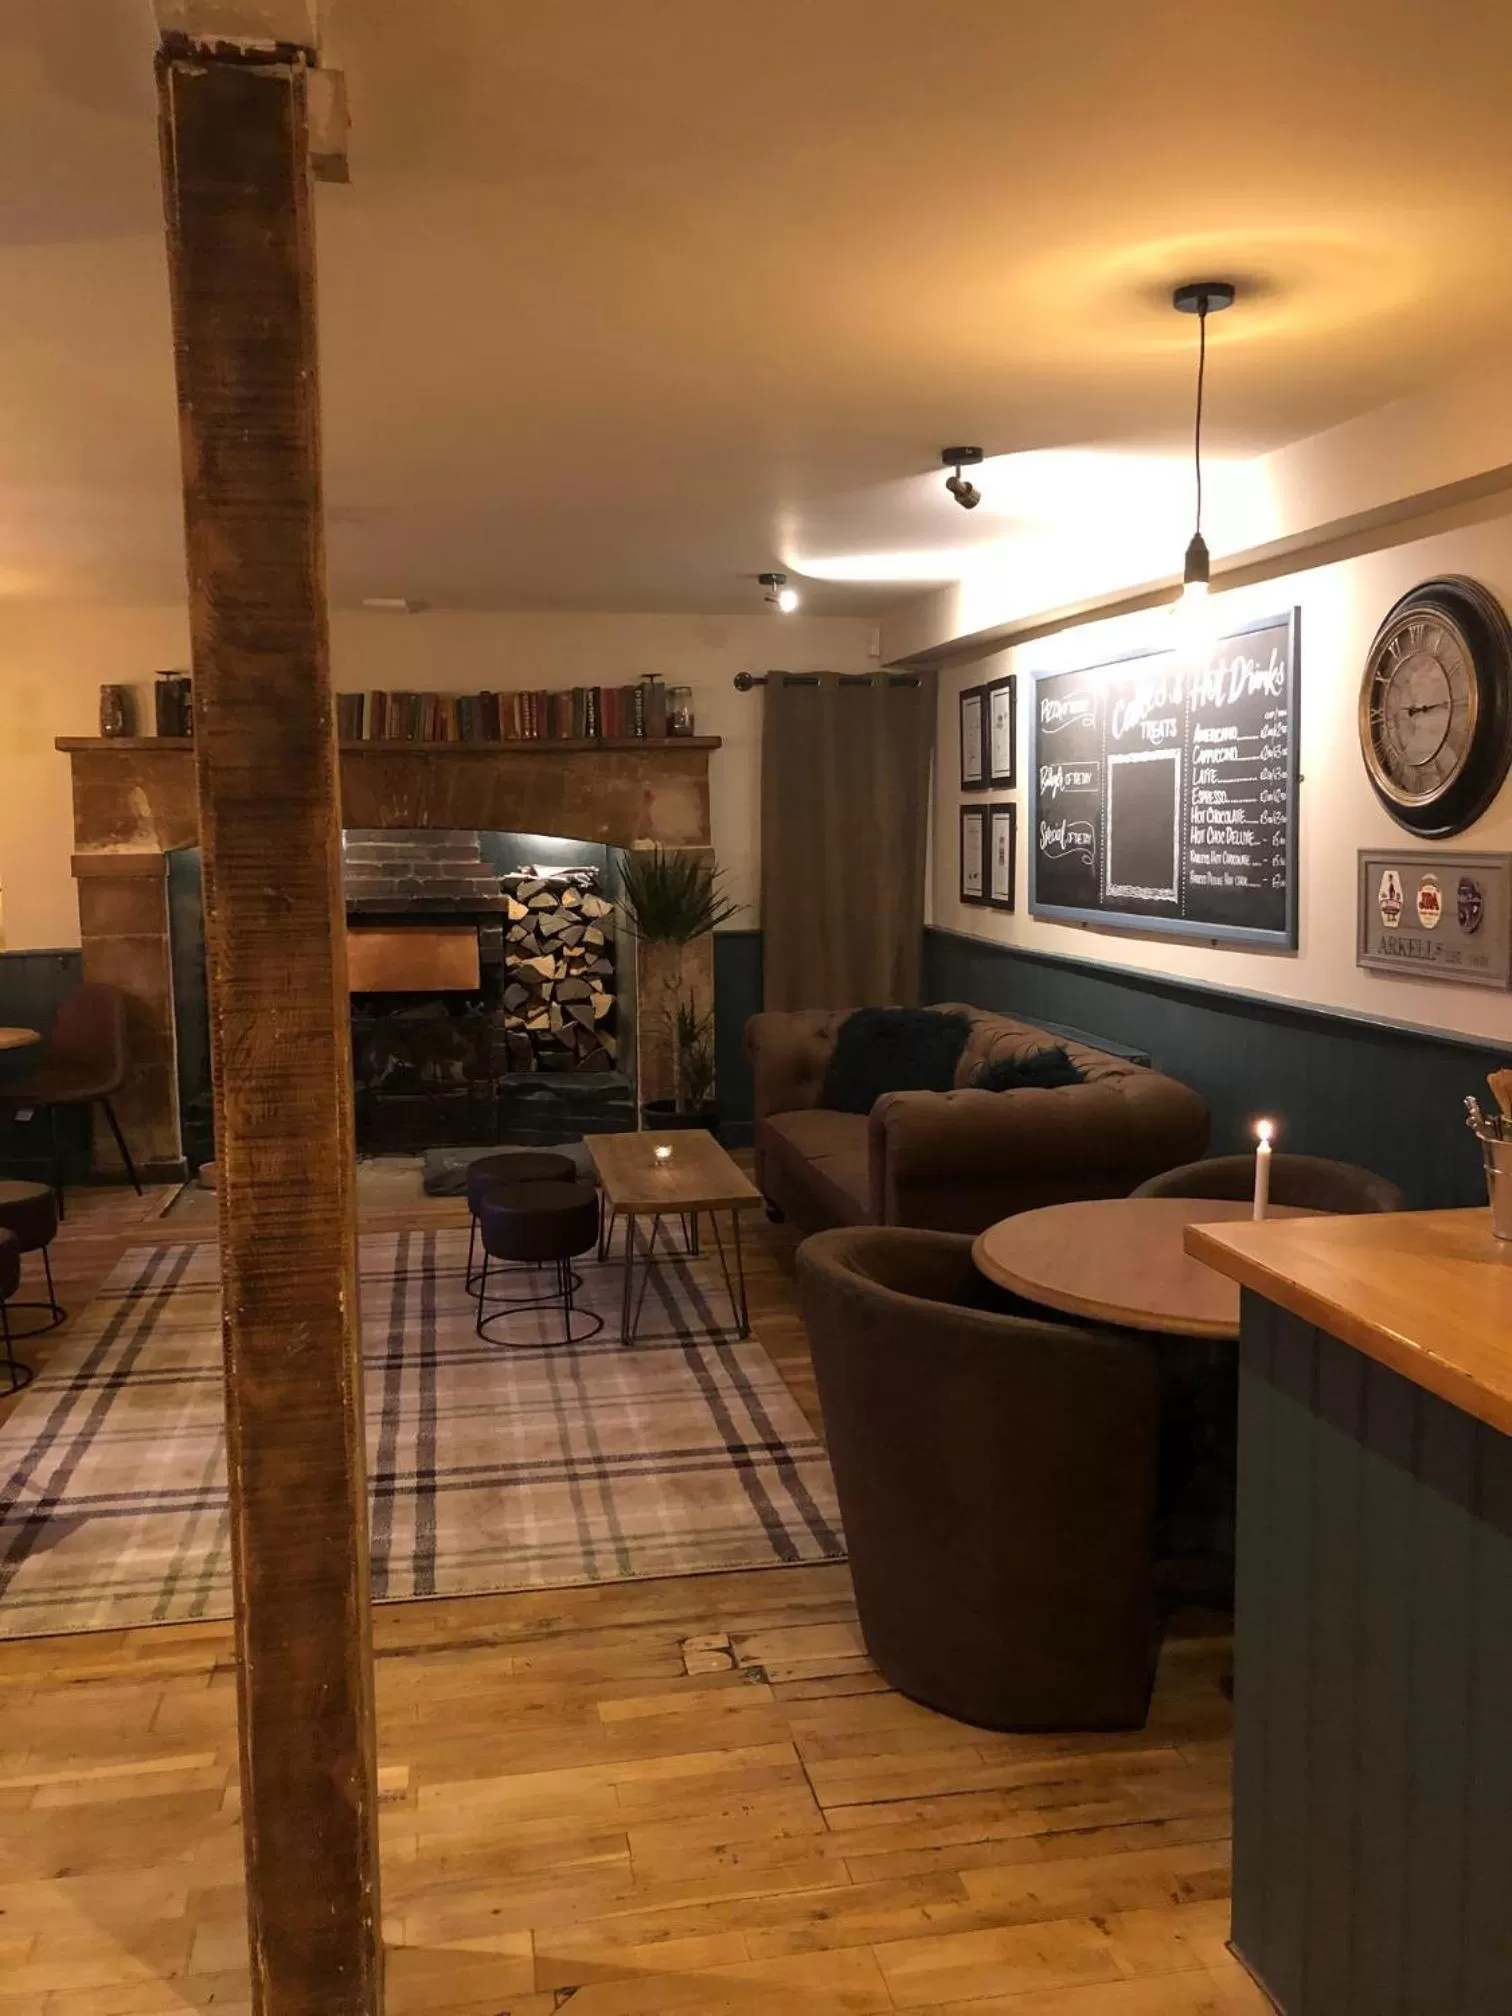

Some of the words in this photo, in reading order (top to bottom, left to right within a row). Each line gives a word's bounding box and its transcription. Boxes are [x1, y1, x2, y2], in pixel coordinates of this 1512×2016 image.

[1227, 648, 1285, 703] Drinks
[1140, 717, 1178, 745] TREATS
[1193, 723, 1238, 744] AMERICANO
[1192, 766, 1219, 786] LATTE
[1191, 786, 1228, 806] ESPRESSO
[1191, 805, 1206, 824] HOT
[1206, 806, 1246, 825] CHOCOLATE
[1190, 825, 1205, 845] HOT
[1206, 825, 1226, 846] CHOC
